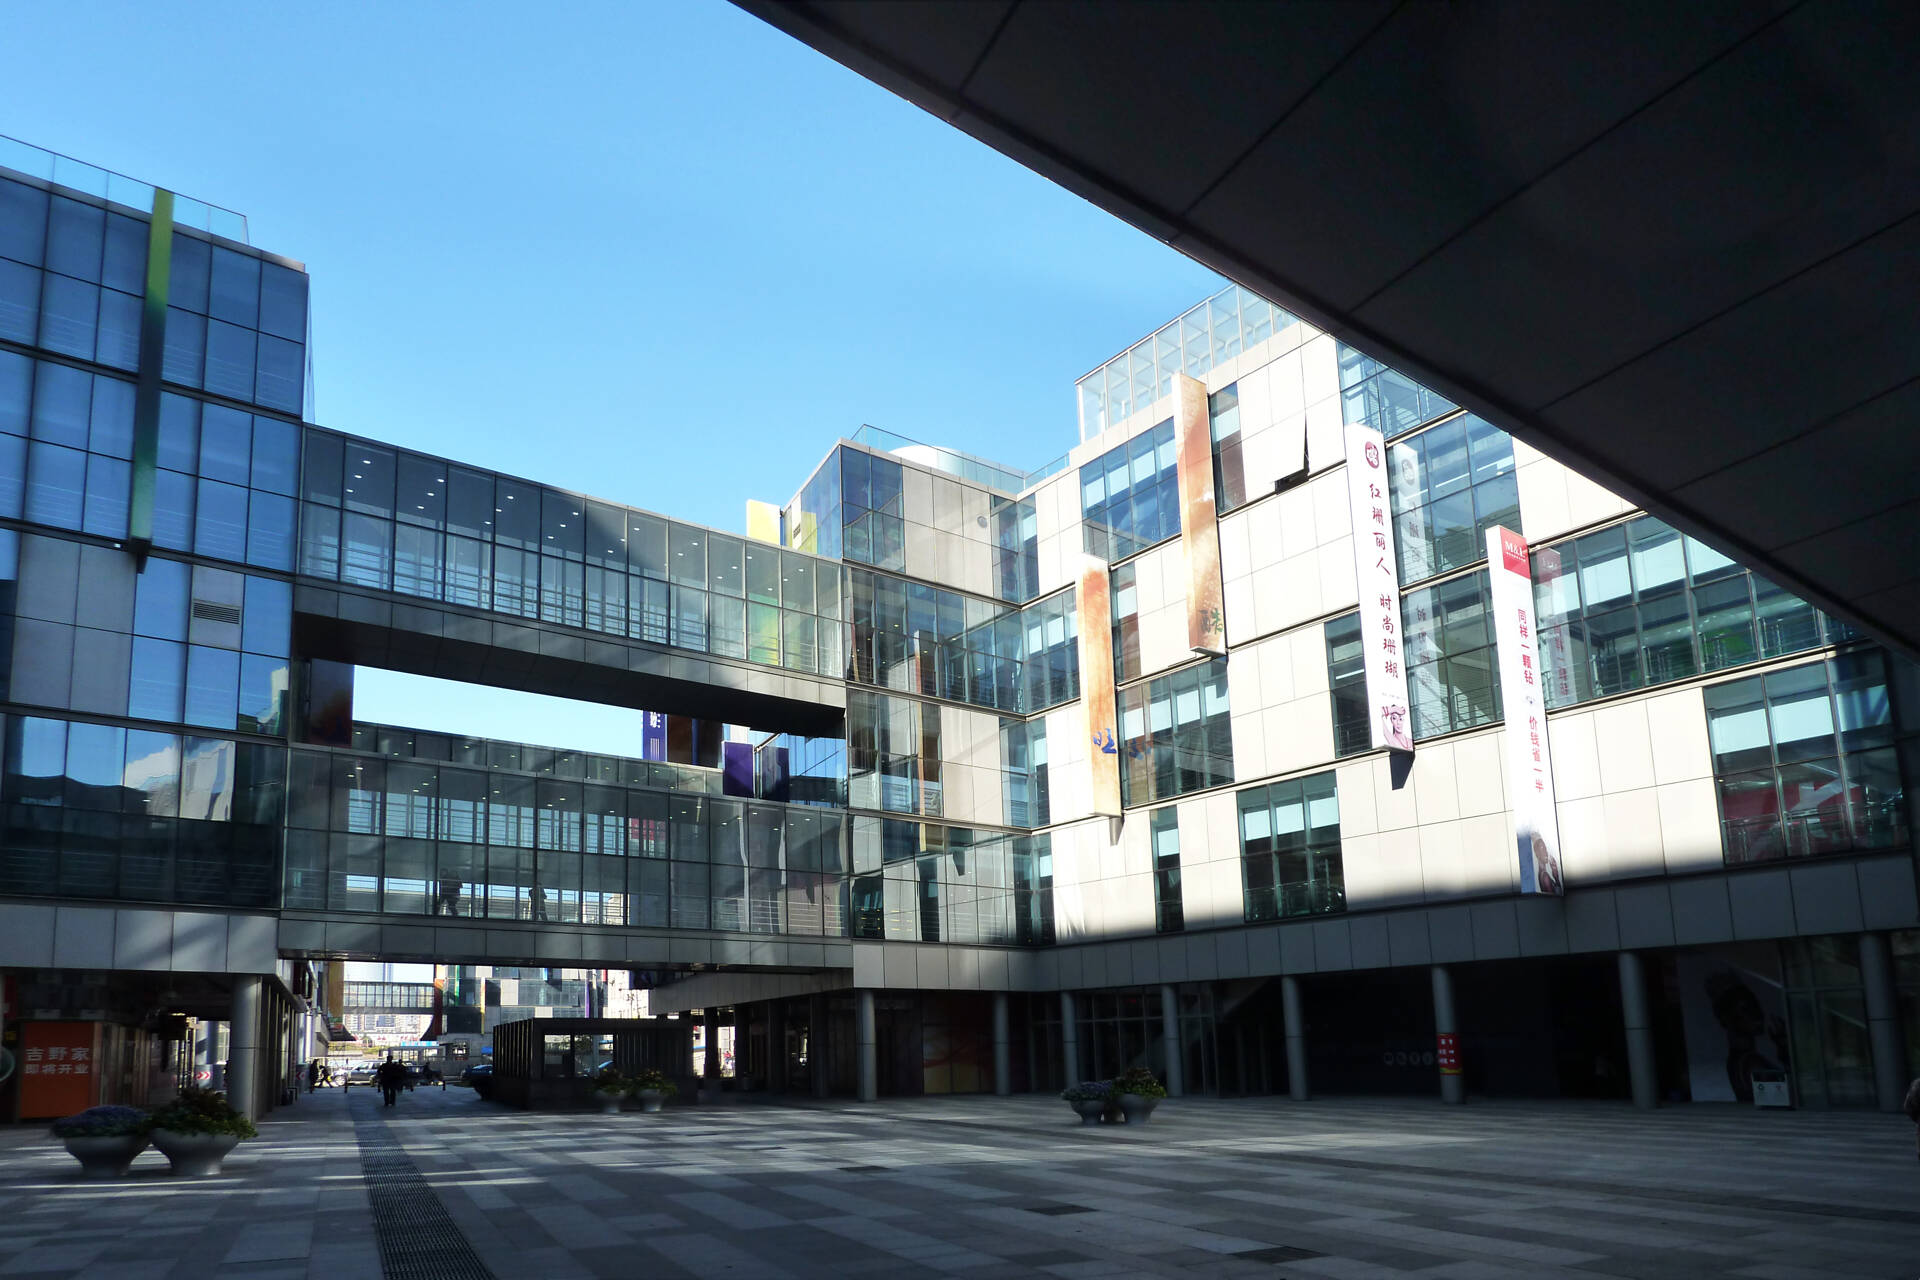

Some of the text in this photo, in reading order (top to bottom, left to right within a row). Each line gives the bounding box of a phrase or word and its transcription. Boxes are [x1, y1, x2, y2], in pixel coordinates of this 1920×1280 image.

[25, 1047, 89, 1061] 吉野家
[25, 1063, 89, 1075] 即将开业
